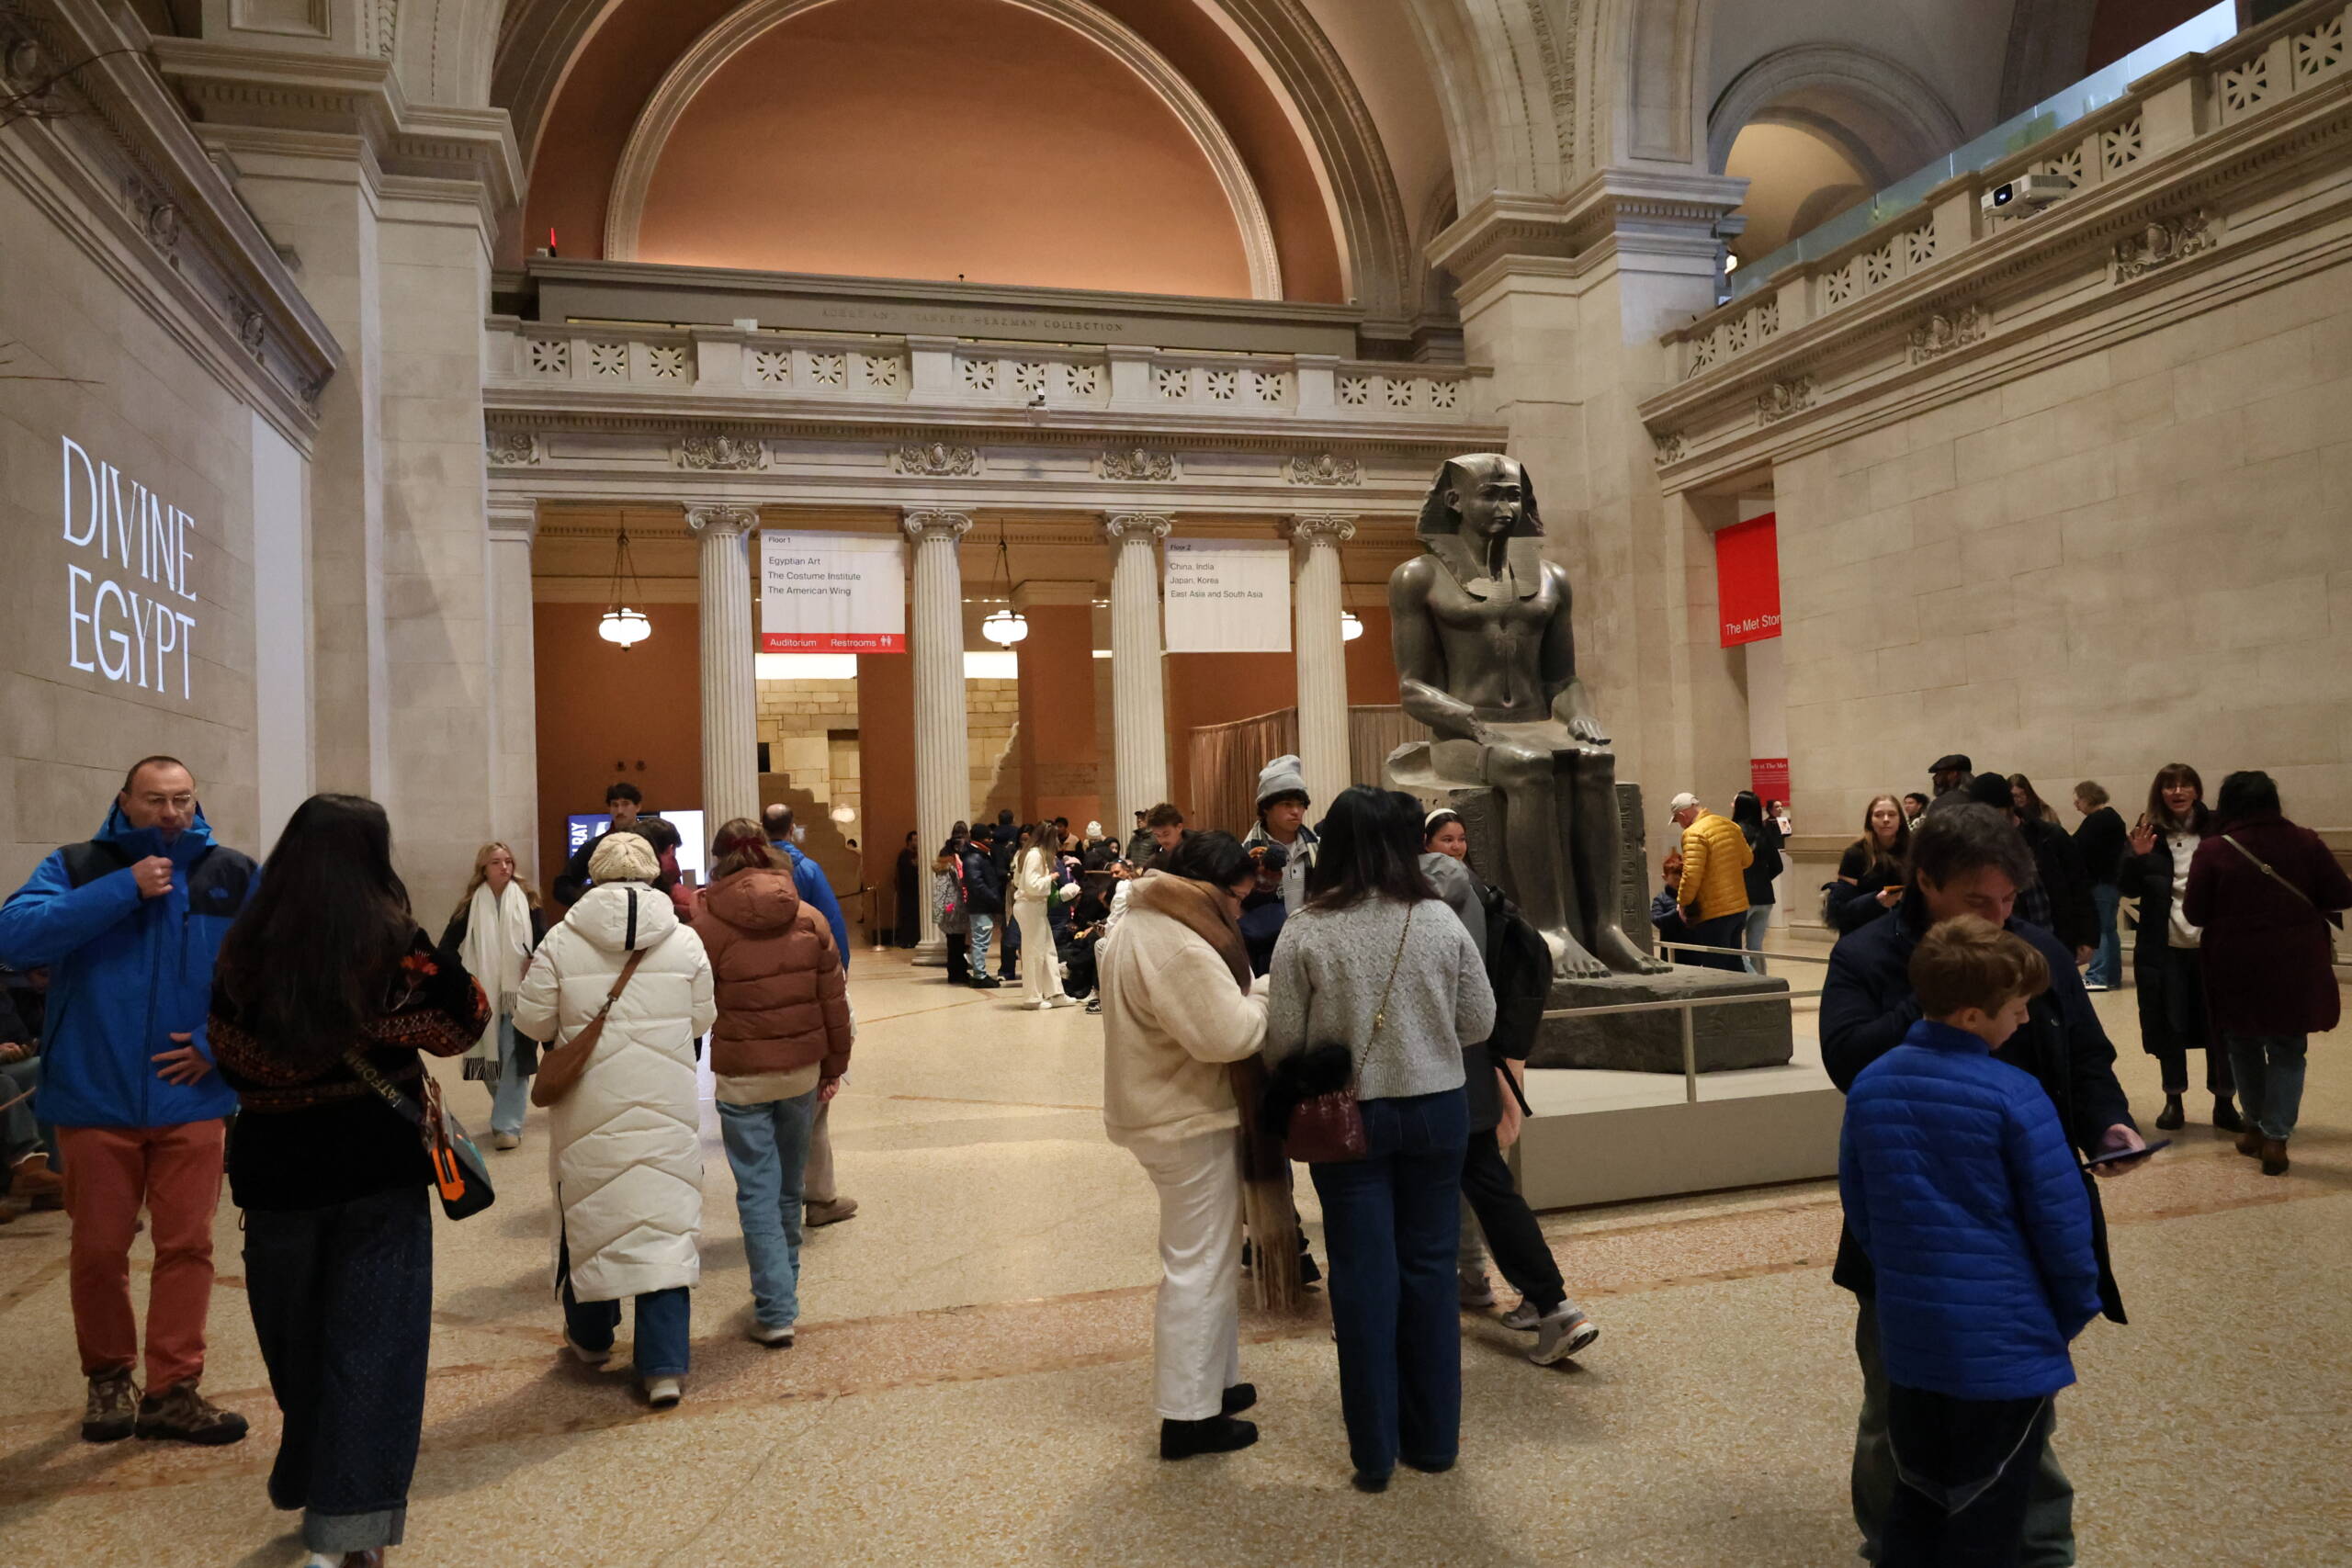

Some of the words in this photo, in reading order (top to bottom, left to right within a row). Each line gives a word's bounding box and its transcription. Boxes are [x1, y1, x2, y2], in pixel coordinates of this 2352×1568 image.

[1044, 320, 1124, 332] COLLECTION
[62, 434, 197, 603] DIVINE
[769, 557, 805, 566] Egyptian
[808, 558, 820, 566] Art
[768, 571, 784, 580] The
[786, 572, 825, 581] Costume
[828, 572, 861, 581] Institute
[768, 586, 784, 594] The
[786, 587, 828, 595] American
[829, 587, 851, 596] Wing
[1725, 624, 1741, 636] The
[1743, 617, 1759, 632] Met
[1761, 614, 1781, 628] Stor
[68, 563, 196, 700] EGYPT
[770, 638, 817, 648] Auditorium
[831, 638, 876, 648] Restrooms
